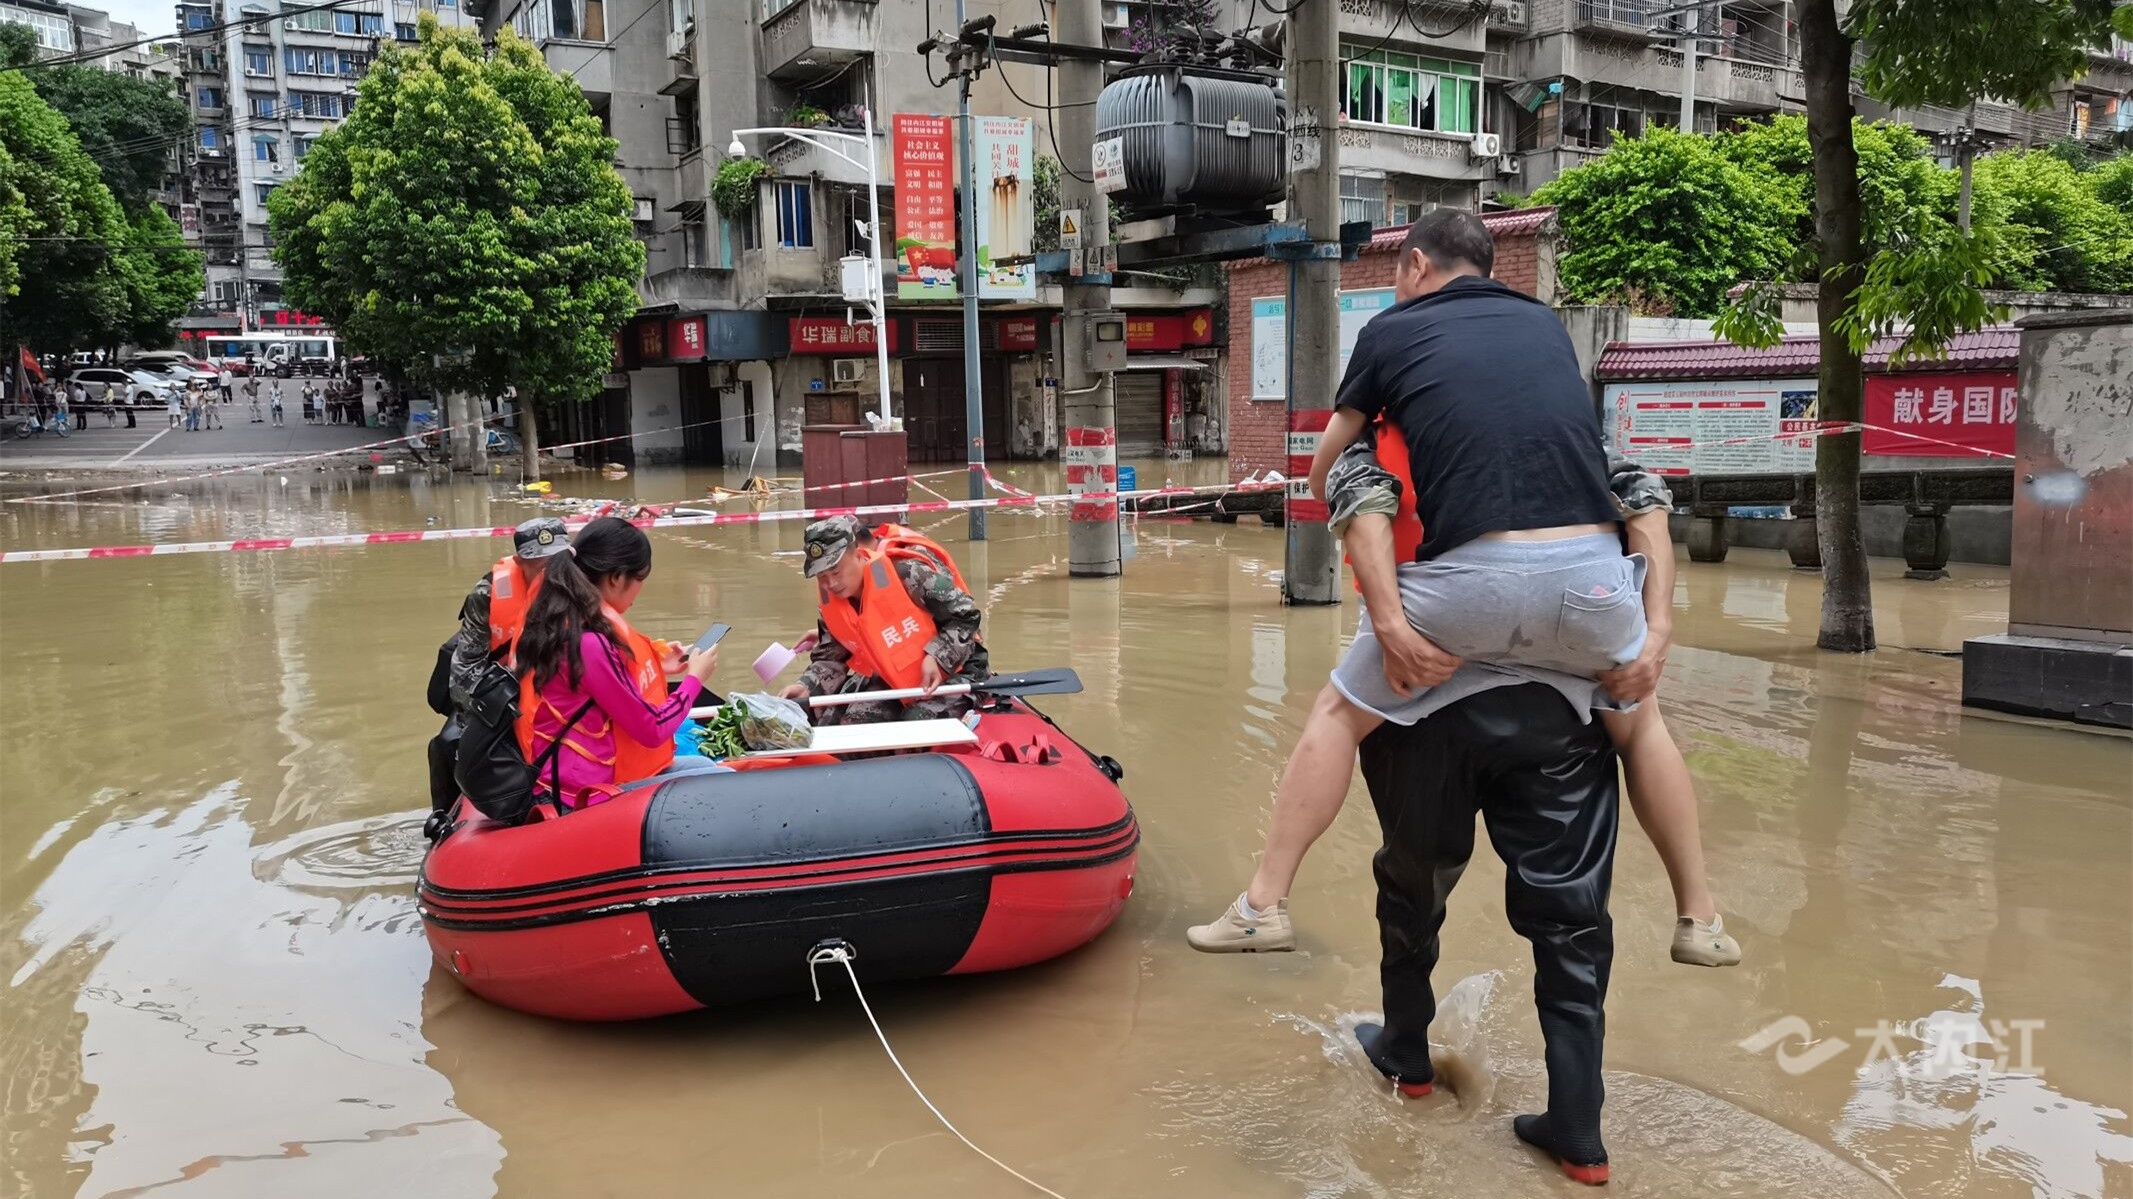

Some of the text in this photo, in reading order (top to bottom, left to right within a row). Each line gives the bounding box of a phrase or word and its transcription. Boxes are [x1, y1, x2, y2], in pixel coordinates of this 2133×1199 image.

[907, 140, 940, 151] 社会主义
[903, 150, 945, 161] 核心价值观
[1294, 143, 1303, 162] 3
[905, 168, 943, 178] 富强 民主
[906, 179, 943, 190] 文明 和谐
[906, 194, 943, 205] 自由 平等
[906, 206, 944, 216] 公正 法治
[907, 220, 945, 230] 爱国 敬业
[929, 231, 945, 241] 友善
[881, 616, 920, 648] 民兵
